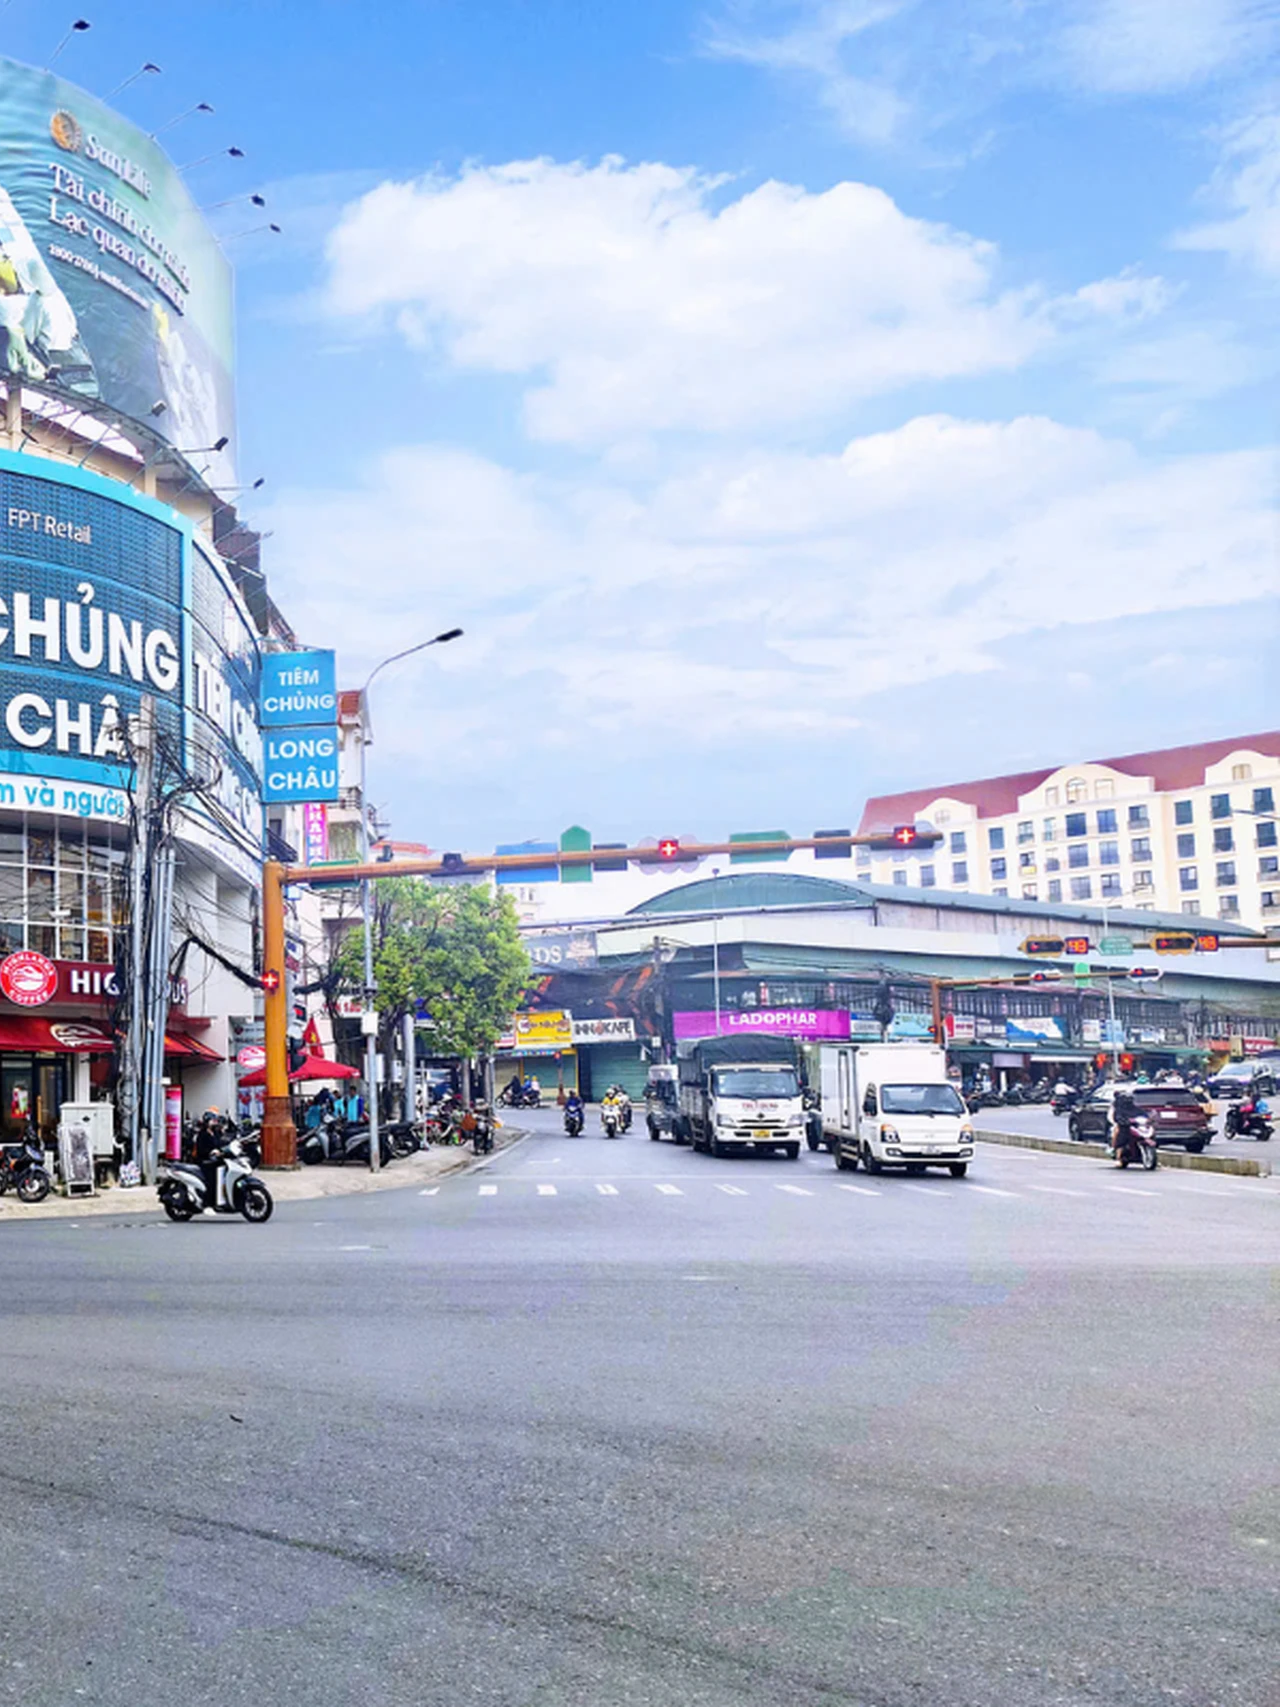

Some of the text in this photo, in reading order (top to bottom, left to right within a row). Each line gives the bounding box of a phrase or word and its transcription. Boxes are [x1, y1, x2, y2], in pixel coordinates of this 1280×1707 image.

[85, 134, 121, 178] Sun
[48, 163, 84, 202] Tài
[48, 195, 89, 236] Lạc
[7, 507, 91, 545] FPT Retail
[277, 667, 320, 686] TIÊM
[263, 689, 336, 713] CHỦNG
[5, 692, 142, 763] CHÂ
[268, 738, 334, 760] LONG
[267, 766, 336, 791] CHÂU
[23, 779, 55, 807] và
[70, 969, 121, 996] HIG
[729, 1011, 818, 1026] LADOPHAR
